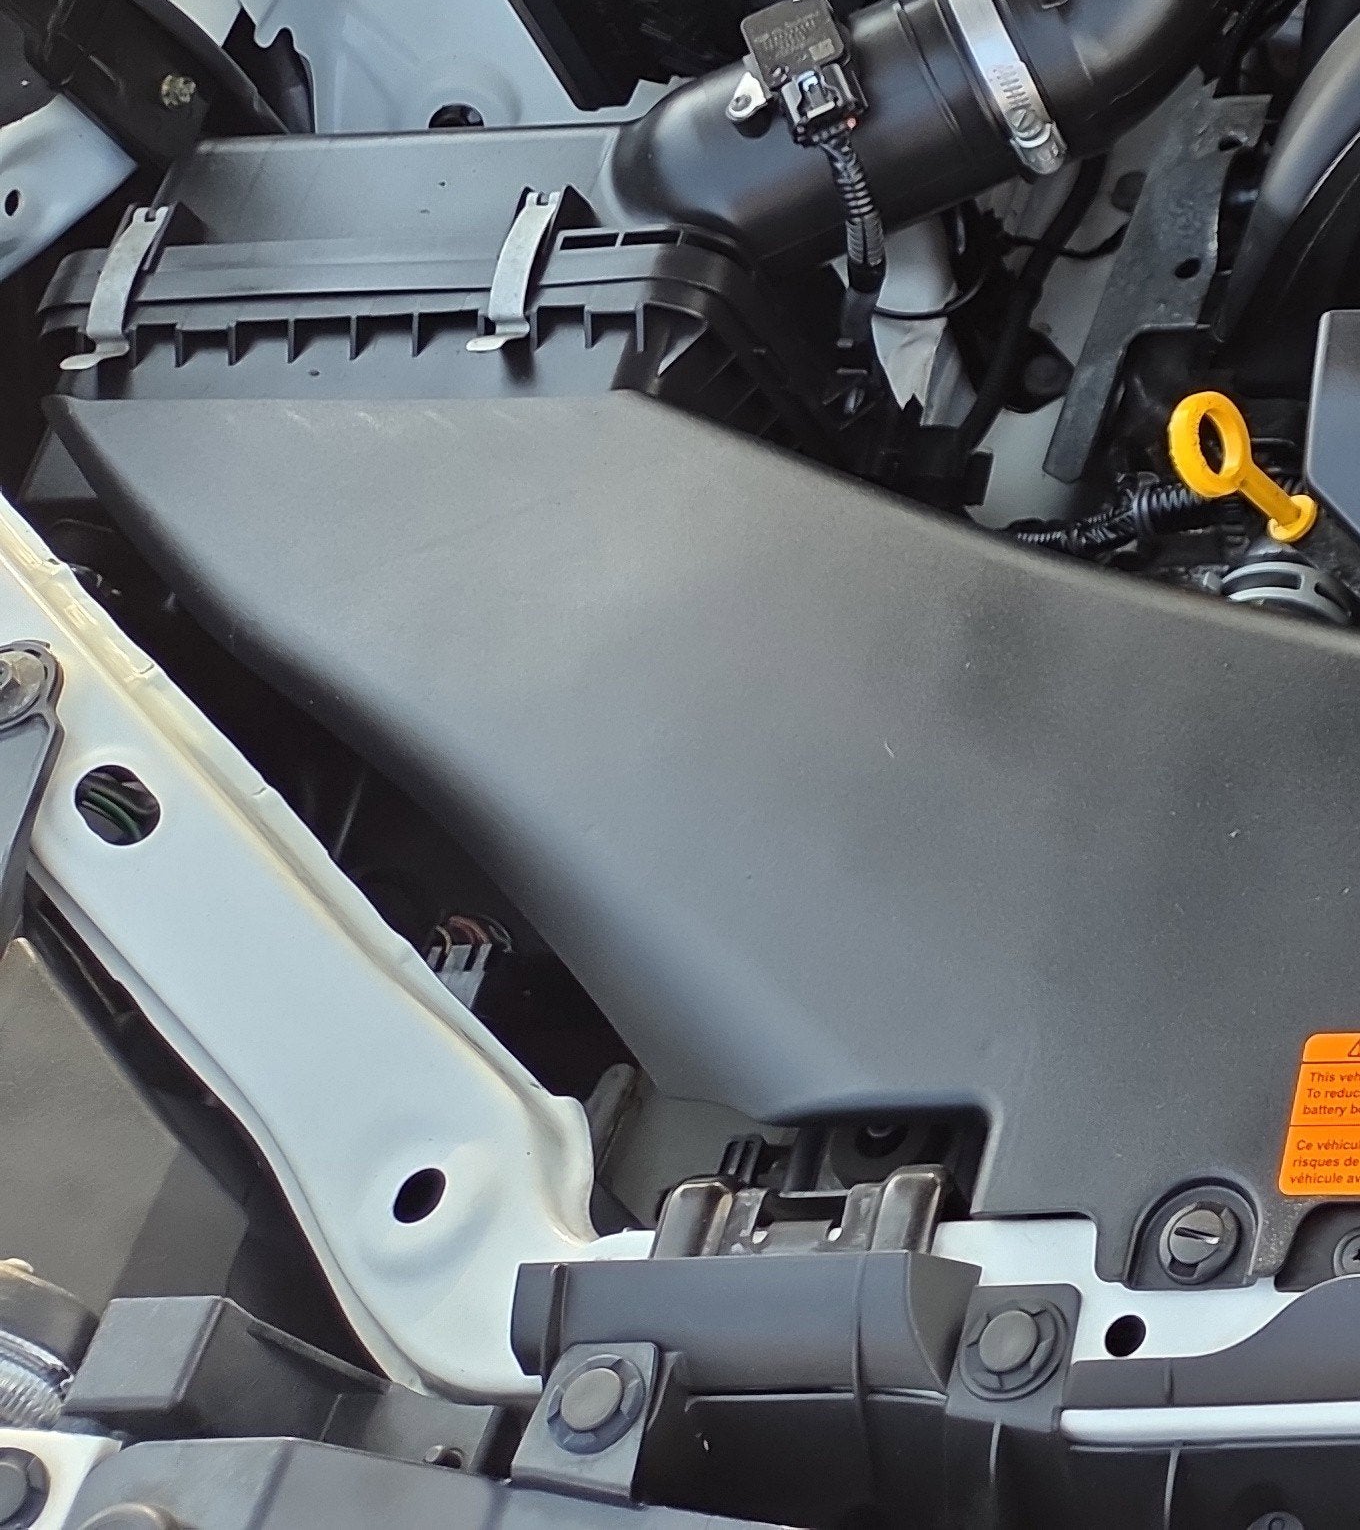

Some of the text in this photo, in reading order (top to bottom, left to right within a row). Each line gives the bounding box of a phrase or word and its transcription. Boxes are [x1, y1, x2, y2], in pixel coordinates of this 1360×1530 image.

[1310, 1071, 1335, 1082] This
[1306, 1088, 1321, 1099] To
[1303, 1103, 1347, 1117] battery
[1296, 1139, 1313, 1151] Ce
[1292, 1157, 1339, 1169] risques
[1344, 1156, 1359, 1167] de
[1289, 1172, 1343, 1185] véhicule
